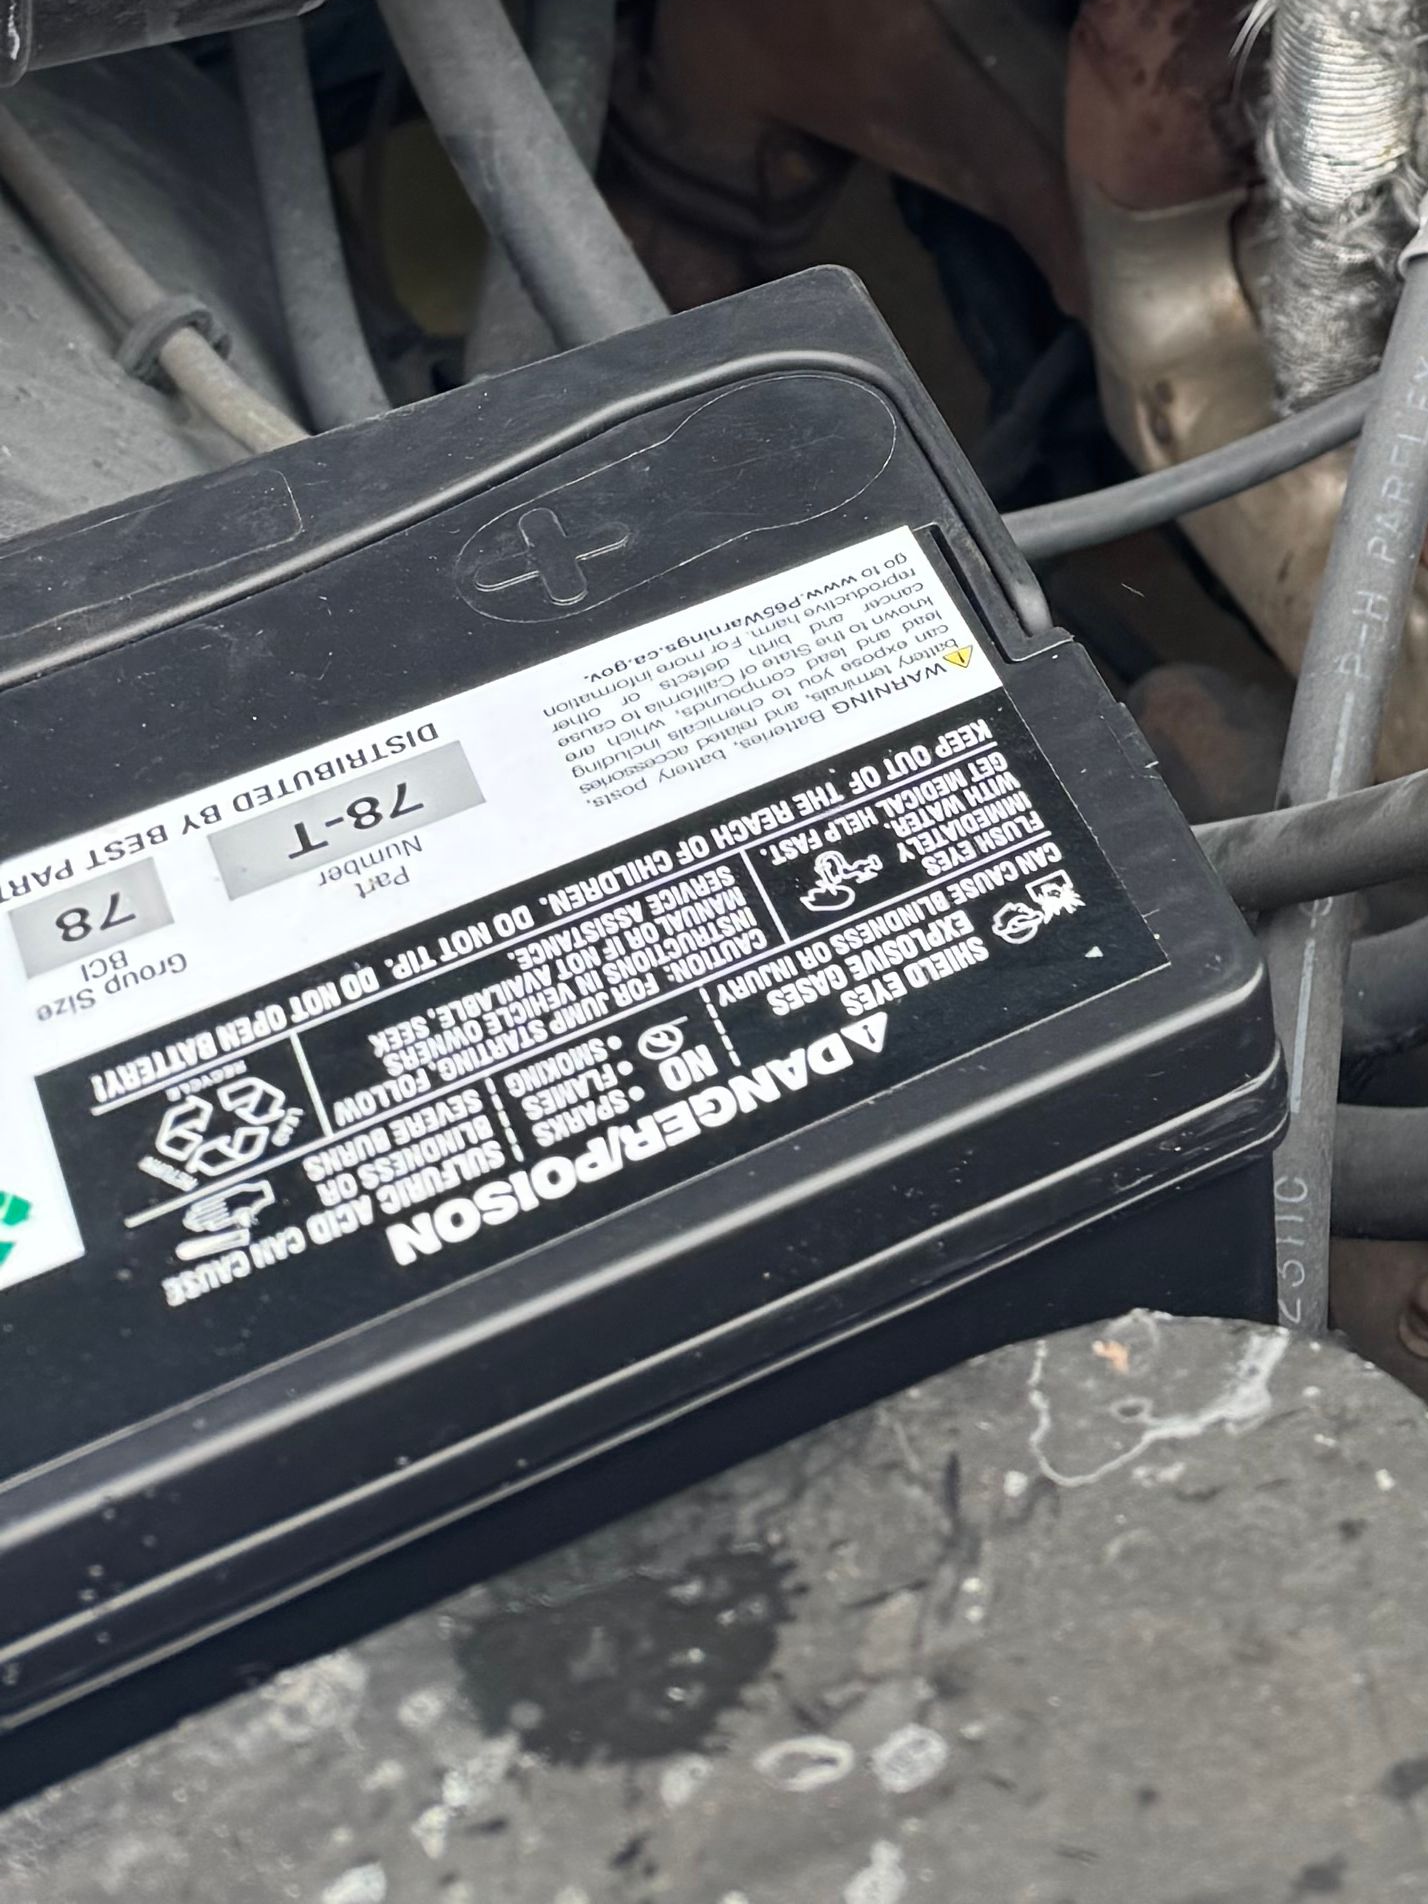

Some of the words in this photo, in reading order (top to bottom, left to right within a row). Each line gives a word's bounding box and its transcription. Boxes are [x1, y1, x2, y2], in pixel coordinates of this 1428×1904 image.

[860, 565, 881, 578] to
[883, 552, 908, 569] go
[803, 567, 916, 617] reproductive
[864, 582, 924, 613] cancer
[871, 595, 934, 625] known
[583, 575, 858, 683] www.P65Warnings.ca.gov.
[745, 613, 801, 638] harm.
[808, 613, 844, 635] and
[815, 630, 846, 647] the
[848, 621, 869, 634] to
[856, 629, 891, 651] and
[902, 609, 943, 633] lead
[914, 624, 949, 643] can
[656, 649, 705, 674] more
[711, 636, 743, 654] For
[748, 634, 793, 656] birth
[762, 643, 812, 668] State
[806, 647, 848, 671] lead
[840, 640, 908, 672] expose
[899, 638, 959, 669] battery
[658, 657, 730, 690] defects
[675, 667, 796, 717] compounds,
[739, 664, 758, 680] of
[798, 667, 835, 690] you
[805, 664, 893, 702] terminals,
[831, 662, 948, 714] WARNING
[542, 670, 653, 717] information
[622, 692, 641, 706] or
[644, 674, 735, 714] California
[764, 701, 799, 723] and
[771, 687, 792, 700] to
[553, 707, 601, 733] other
[557, 719, 617, 747] cause
[606, 719, 666, 746] which
[620, 710, 641, 723] to
[667, 697, 764, 741] chemicals
[696, 717, 758, 751] related
[733, 709, 826, 749] Batteries,
[565, 744, 595, 762] are
[571, 738, 661, 778] including
[934, 718, 993, 759] KEEP
[232, 722, 439, 813] DISTRIBUTED
[579, 745, 689, 794] accessories
[658, 749, 727, 783] battery
[848, 765, 882, 795] OF
[882, 744, 932, 781] OUT
[967, 751, 1008, 783] GET
[586, 776, 648, 808] posts,
[791, 781, 845, 817] THE
[874, 768, 969, 818] MEDICAL
[962, 771, 1022, 808] WITH
[182, 804, 222, 835] BY
[288, 782, 425, 860] 78-T
[709, 800, 795, 850] REACH
[823, 806, 879, 843] HELP
[883, 794, 967, 838] WATER.
[896, 790, 1033, 864] IMMEDIATELY
[966, 810, 1045, 857] FLUSH
[86, 824, 169, 871] BEST
[319, 835, 423, 887] Number
[675, 835, 710, 866] OF
[759, 828, 824, 866] FAST.
[921, 840, 975, 877] EYES
[1014, 841, 1063, 875] CAN
[355, 865, 410, 899] Part
[538, 849, 674, 916] CHILDREN.
[644, 865, 736, 916] SERVICE
[946, 860, 1020, 906] CAUSE
[55, 892, 137, 942] 78
[492, 904, 535, 938] DO
[653, 886, 747, 936] MANUAL
[829, 890, 951, 956] BLINDNESS
[438, 921, 493, 962] NOT
[507, 900, 644, 971] ASSISTANCE.
[597, 906, 758, 985] INSTRUCTIONS
[602, 935, 626, 961] IF
[623, 921, 660, 950] OR
[662, 927, 768, 984] CAUTION:
[844, 909, 975, 982] EXPLOSIVE
[80, 949, 129, 982] BCI
[104, 953, 188, 995] Group
[384, 945, 438, 980] TIP.
[555, 945, 602, 981] NOT
[794, 941, 833, 971] OR
[902, 936, 990, 989] SHIELD
[339, 966, 380, 1001] DO
[426, 960, 553, 1030] AVAILABLE,
[574, 969, 604, 997] IN
[610, 972, 660, 1008] FOR
[716, 955, 799, 1008] INJURY
[766, 964, 849, 1016] GASES
[840, 971, 908, 1017] EYES
[36, 988, 96, 1022] Size
[289, 981, 342, 1023] NOT
[481, 982, 577, 1036] VEHICLE
[548, 991, 610, 1035] JUMP
[215, 1004, 288, 1052] OPEN
[368, 1015, 430, 1058] SEEK
[377, 1019, 484, 1077] OWNERS
[90, 1031, 218, 1103] BATTERY!
[424, 1019, 549, 1082] STARTING,
[503, 1037, 609, 1098] SMOKING
[658, 1044, 719, 1092] NO
[333, 1065, 432, 1127] FOLLOW
[521, 1063, 619, 1121] FLAMES
[388, 1088, 484, 1146] SEVERE
[531, 1088, 630, 1148] SPARKS
[302, 1127, 392, 1182] BURNS
[357, 1114, 494, 1190] BLINDNESS
[385, 1032, 854, 1266] DANGER/POISON
[316, 1172, 358, 1207] OR
[375, 1140, 506, 1215] SULFURIC
[306, 1194, 374, 1245] ACID
[244, 1226, 306, 1269] CAN
[162, 1250, 251, 1307] CAUSE
